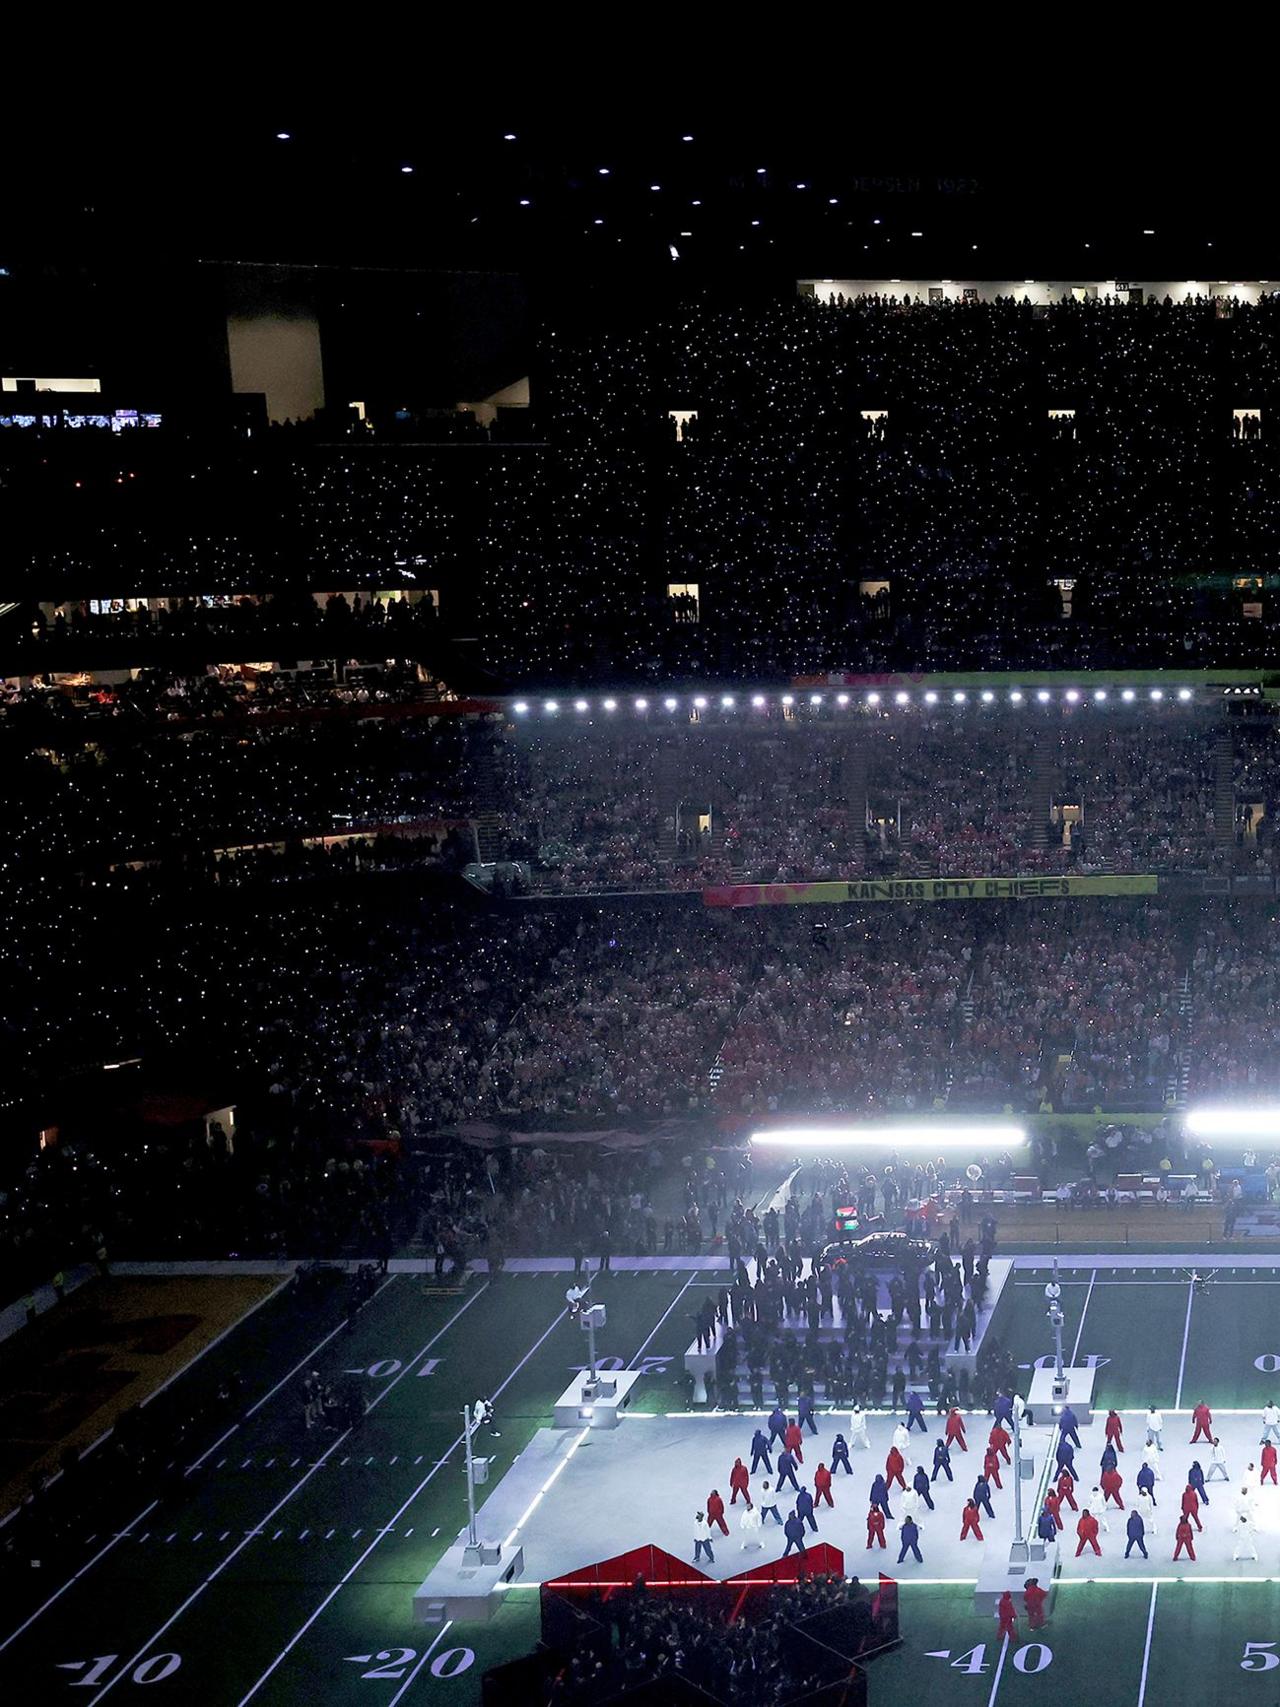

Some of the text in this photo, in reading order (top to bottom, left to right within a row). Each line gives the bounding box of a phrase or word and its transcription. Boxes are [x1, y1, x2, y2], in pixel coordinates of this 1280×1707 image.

[848, 879, 1069, 899] KANSAS CITY CHIEFS
[367, 1357, 447, 1377] 10
[68, 1652, 183, 1686] 10
[360, 1647, 476, 1679] 20
[950, 1643, 1053, 1674] 40
